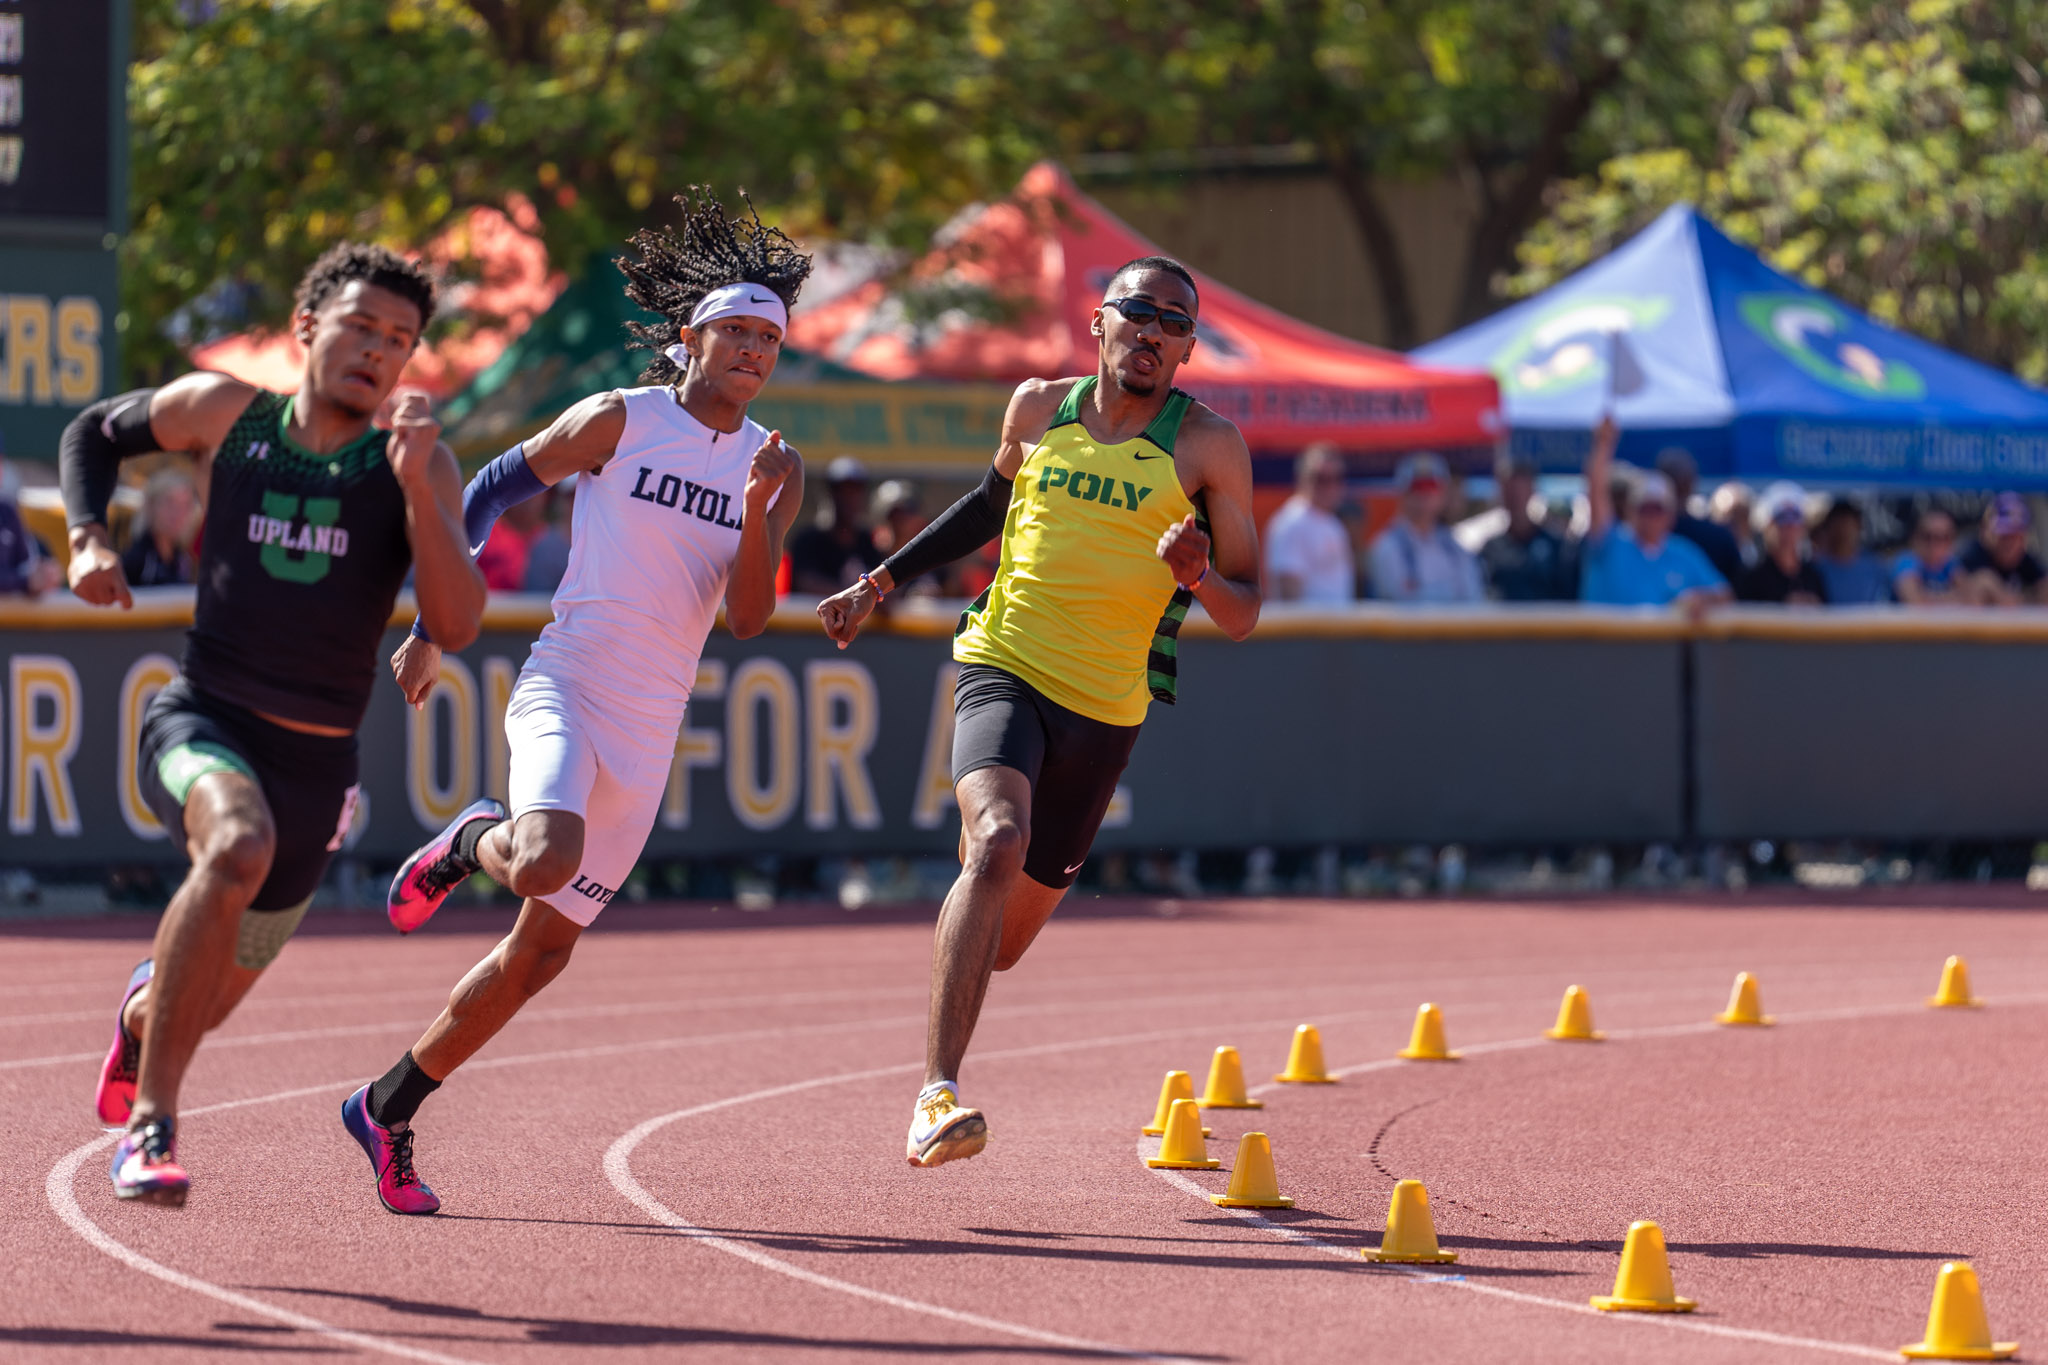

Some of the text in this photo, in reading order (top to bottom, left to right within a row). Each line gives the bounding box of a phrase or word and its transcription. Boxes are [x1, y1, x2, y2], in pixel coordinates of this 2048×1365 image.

[0, 292, 103, 407] RS
[630, 466, 743, 531] LOYOL
[1038, 466, 1153, 513] POLY
[247, 513, 350, 558] UPLAND
[660, 656, 882, 832] FOR
